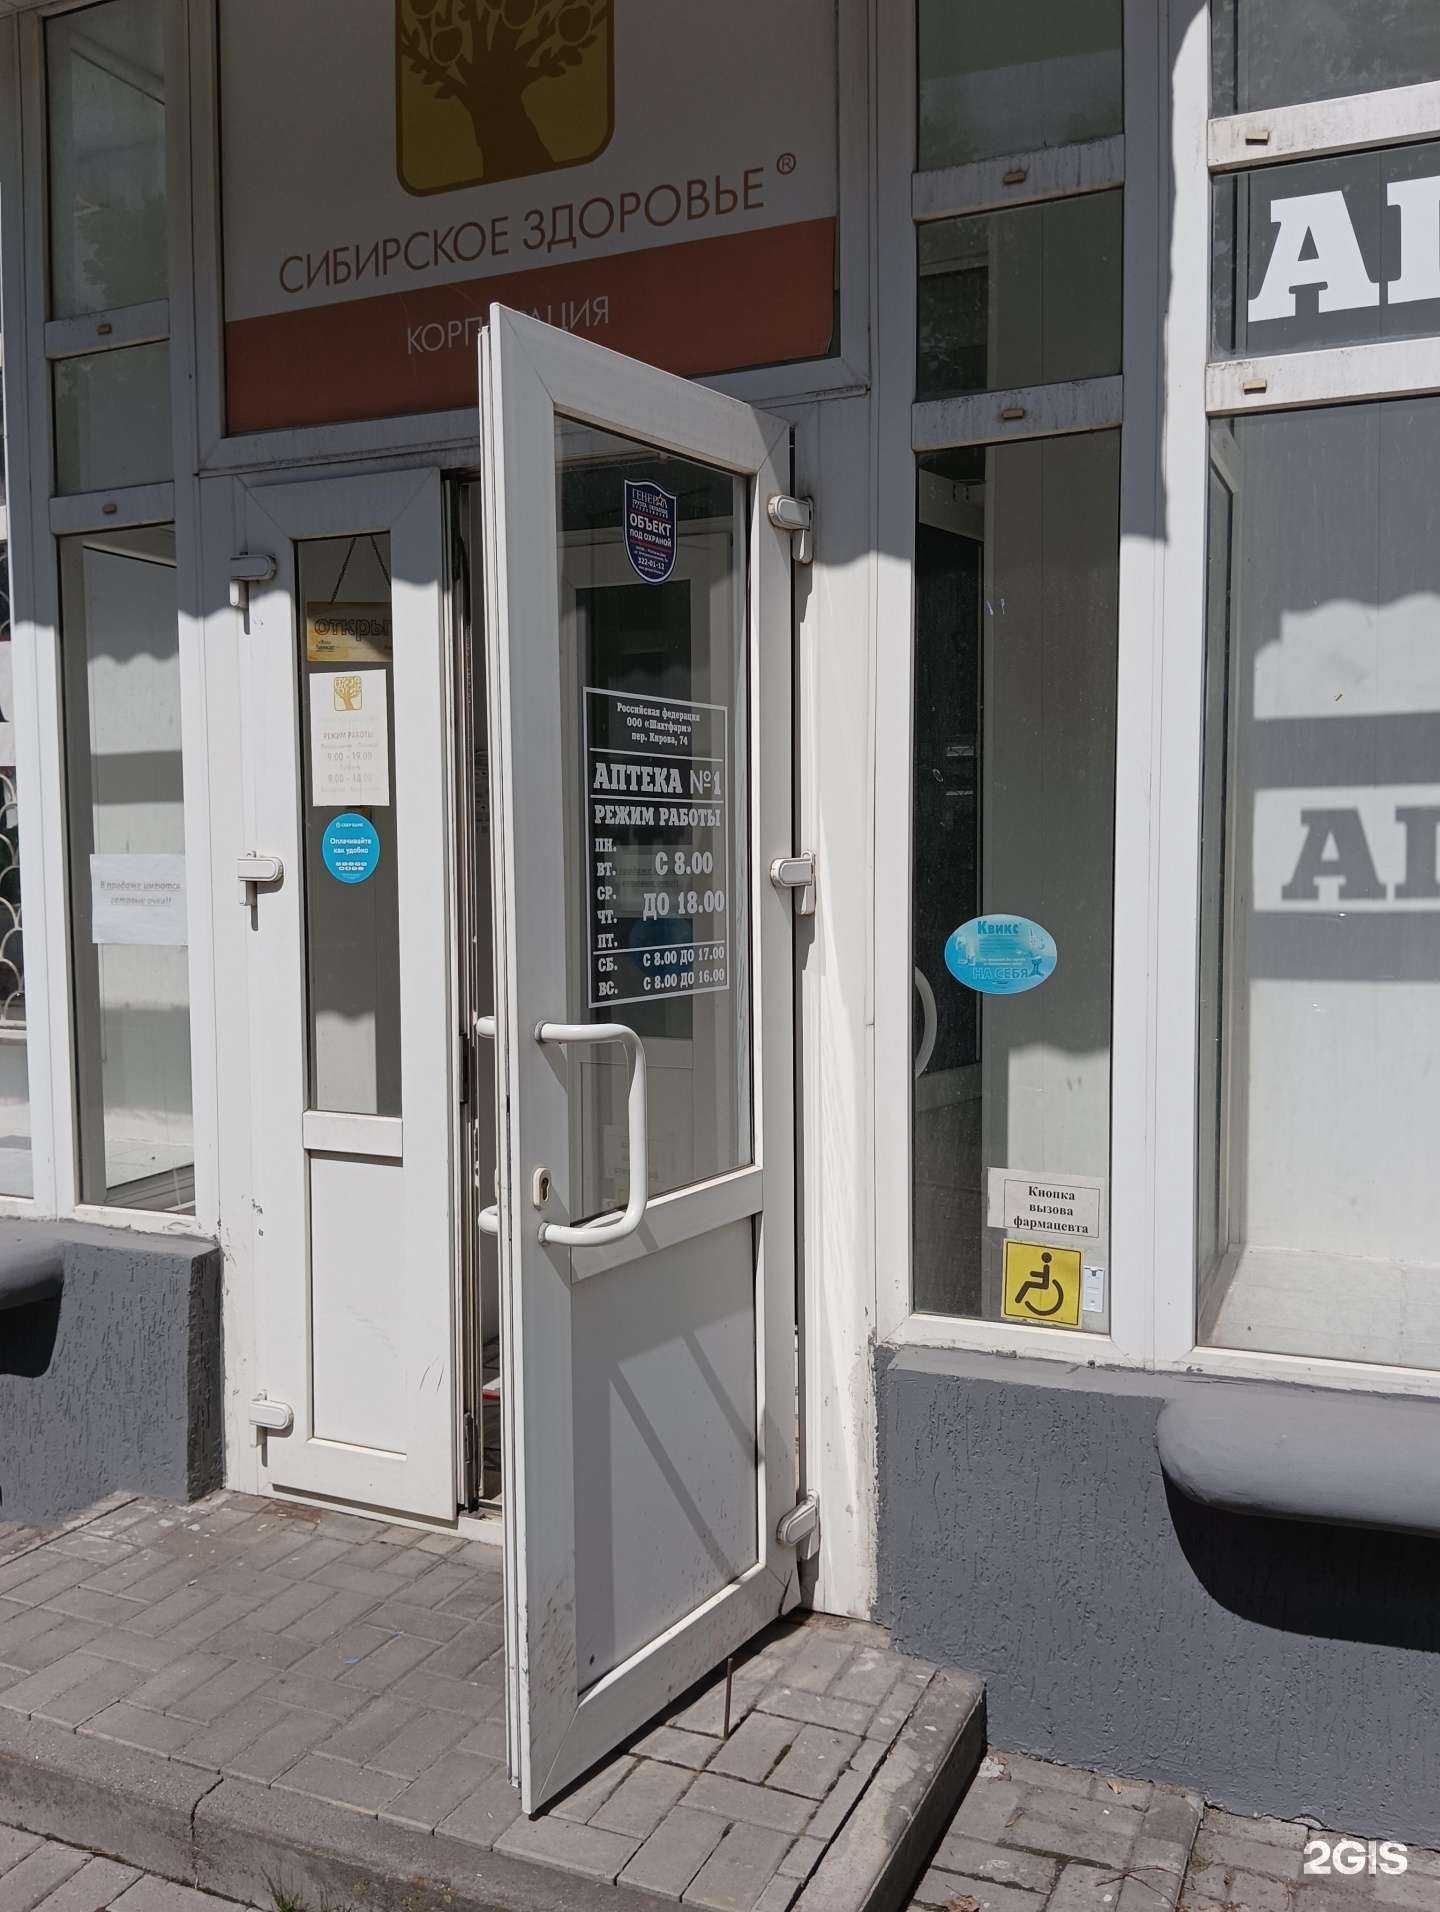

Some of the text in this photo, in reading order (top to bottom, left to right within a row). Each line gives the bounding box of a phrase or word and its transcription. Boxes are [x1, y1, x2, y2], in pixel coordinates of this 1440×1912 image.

[279, 216, 509, 294] СИБИРСКОЕ
[523, 167, 765, 253] ЗДОРОВЬЕ
[629, 513, 672, 536] ОБЪЕКТ
[629, 528, 672, 547] ПОД ОХРАНОЙ
[617, 702, 700, 722] Российская федерация
[626, 716, 643, 728] ООО
[631, 731, 689, 746] пер. Кирова, 74
[593, 762, 683, 794] АПТЕКА
[594, 804, 721, 827] РЕЖИМ РАБОТЫ
[329, 837, 372, 845] Оплачивайте
[595, 838, 617, 852] ПН.
[346, 846, 369, 855] удобно
[597, 862, 616, 876] ВТ.
[655, 851, 713, 875] С 8.00
[597, 886, 617, 900] СР.
[642, 890, 724, 921] ДО 18.00
[597, 910, 618, 924] ЧТ.
[977, 921, 1019, 935] Квикс
[597, 933, 618, 948] ПТ.
[598, 946, 724, 972] СБ. С 8.00 ДО 17.00
[995, 967, 1028, 979] СЕБЯ
[598, 968, 724, 996] ВС. С 8.00 ДО 16.00
[1028, 1186, 1076, 1200] Кнопка
[1029, 1204, 1074, 1216] вызова
[1013, 1215, 1089, 1234] фармацевта
